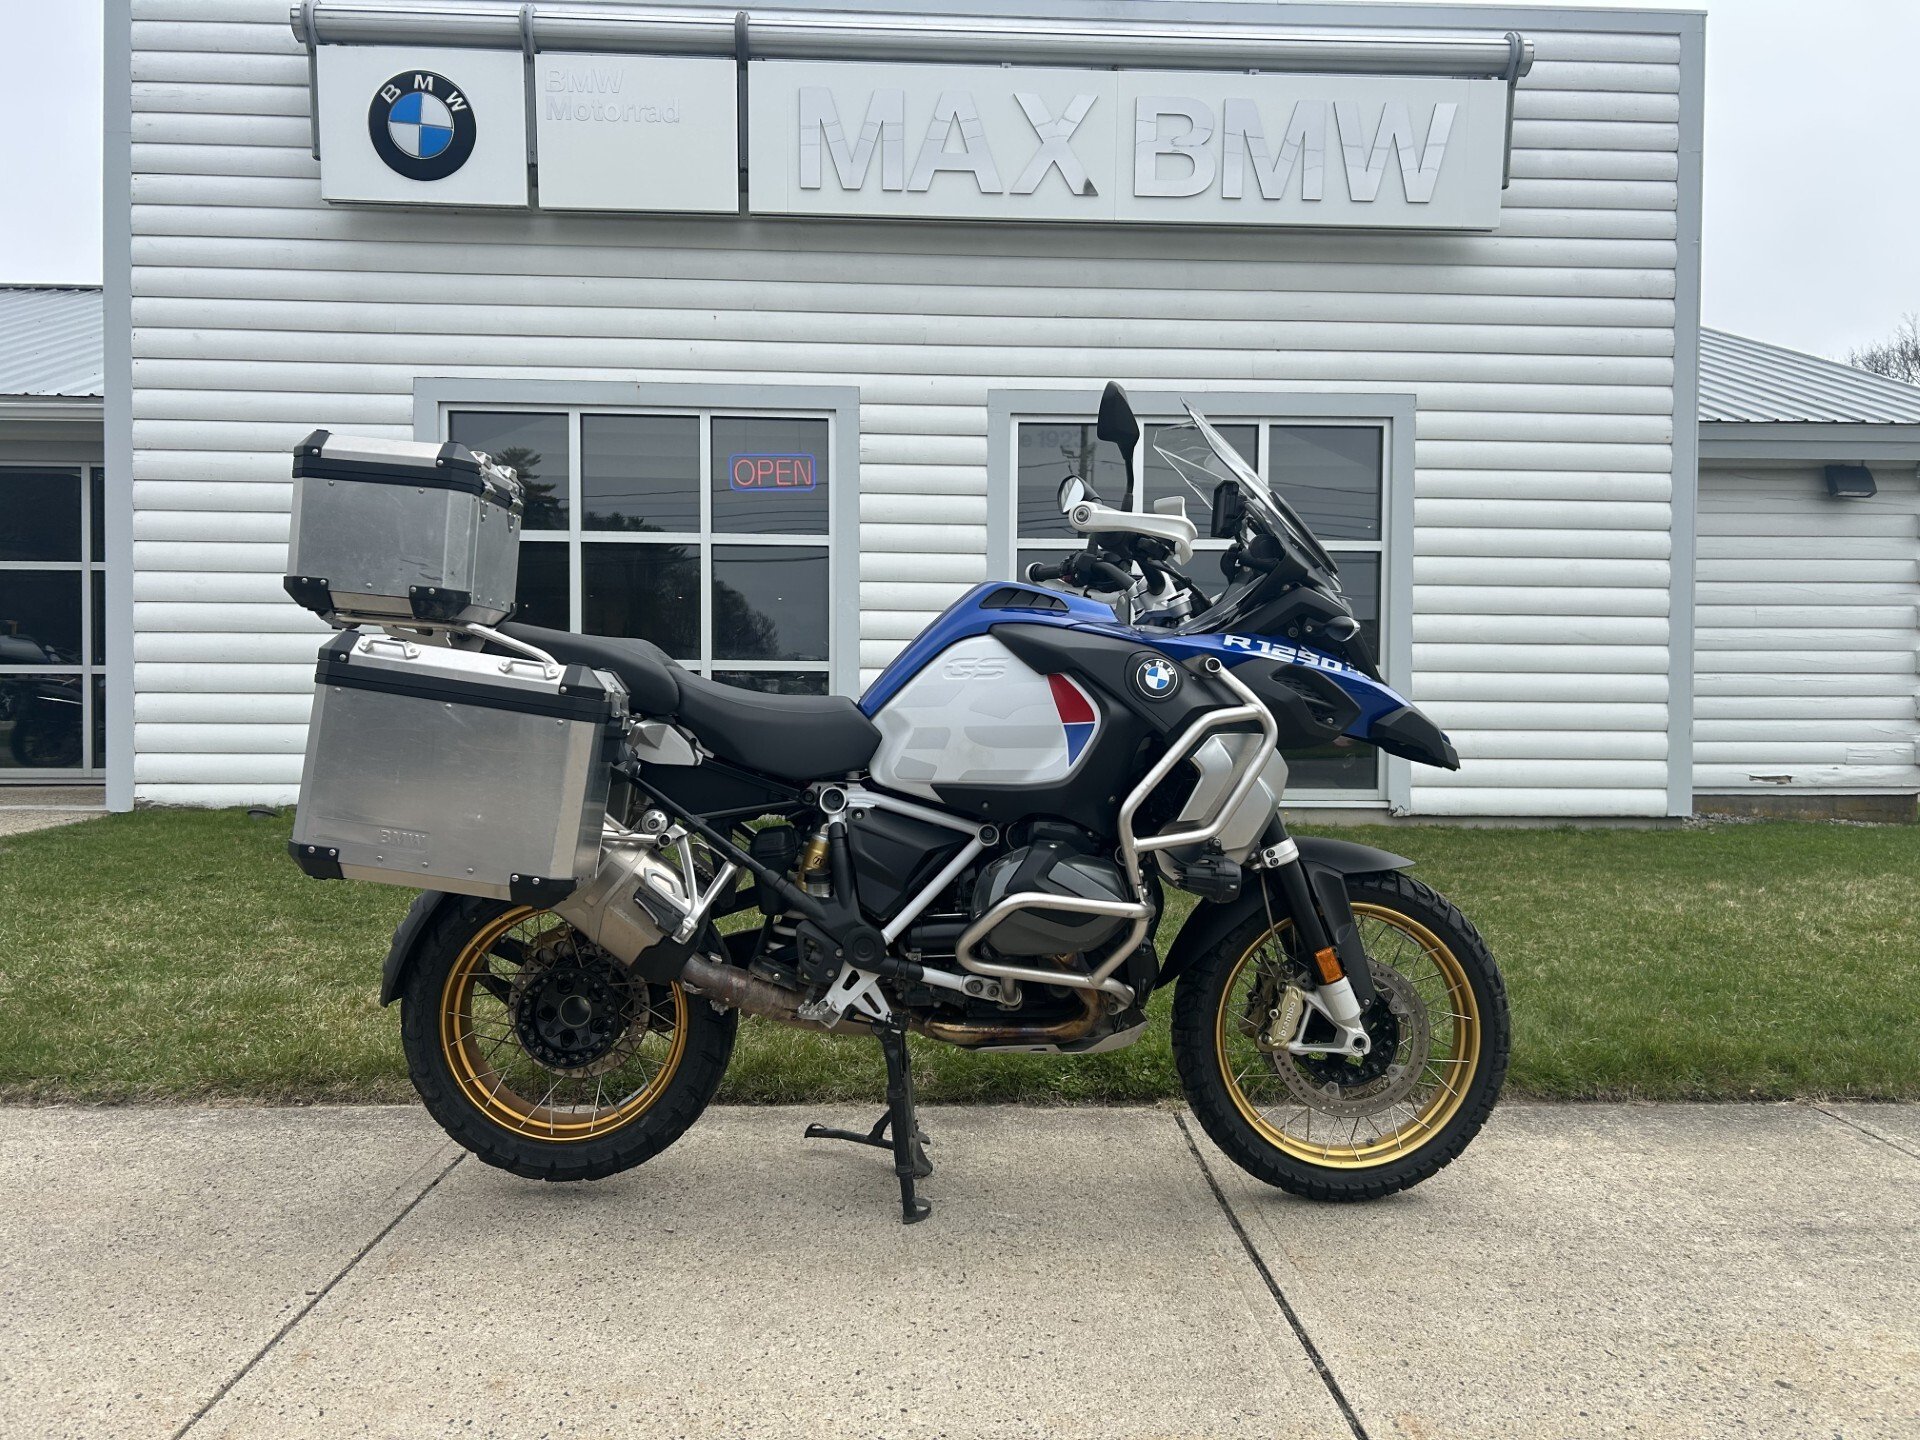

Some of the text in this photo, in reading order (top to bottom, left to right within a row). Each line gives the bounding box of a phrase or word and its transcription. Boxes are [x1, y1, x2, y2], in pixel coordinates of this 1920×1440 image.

[381, 74, 467, 113] BMW
[545, 68, 624, 94] BMW
[546, 96, 680, 123] Motorrad
[799, 87, 1458, 203] MAX BMW
[734, 459, 812, 486] OPEN
[943, 657, 1010, 680] GS
[1143, 660, 1174, 675] BMW
[1279, 1002, 1296, 1037] brembo
